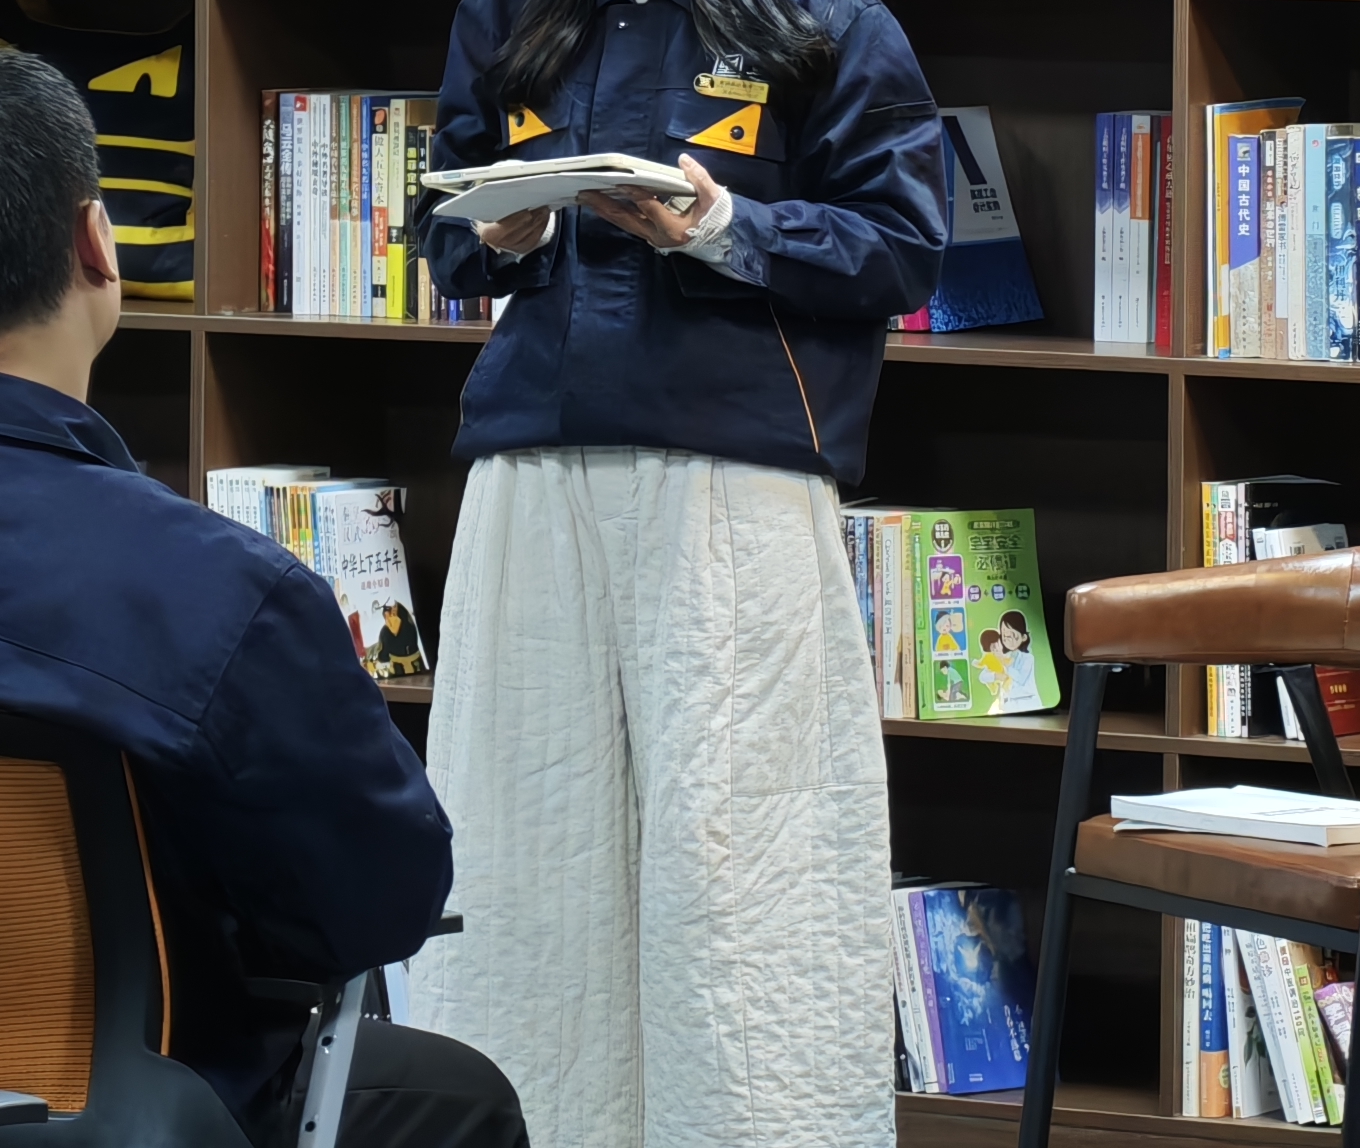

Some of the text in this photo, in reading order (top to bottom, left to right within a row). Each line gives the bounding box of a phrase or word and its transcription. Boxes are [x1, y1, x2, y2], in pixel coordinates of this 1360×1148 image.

[1237, 164, 1251, 236] 中国古代史
[342, 548, 402, 579] 中华上下五千年
